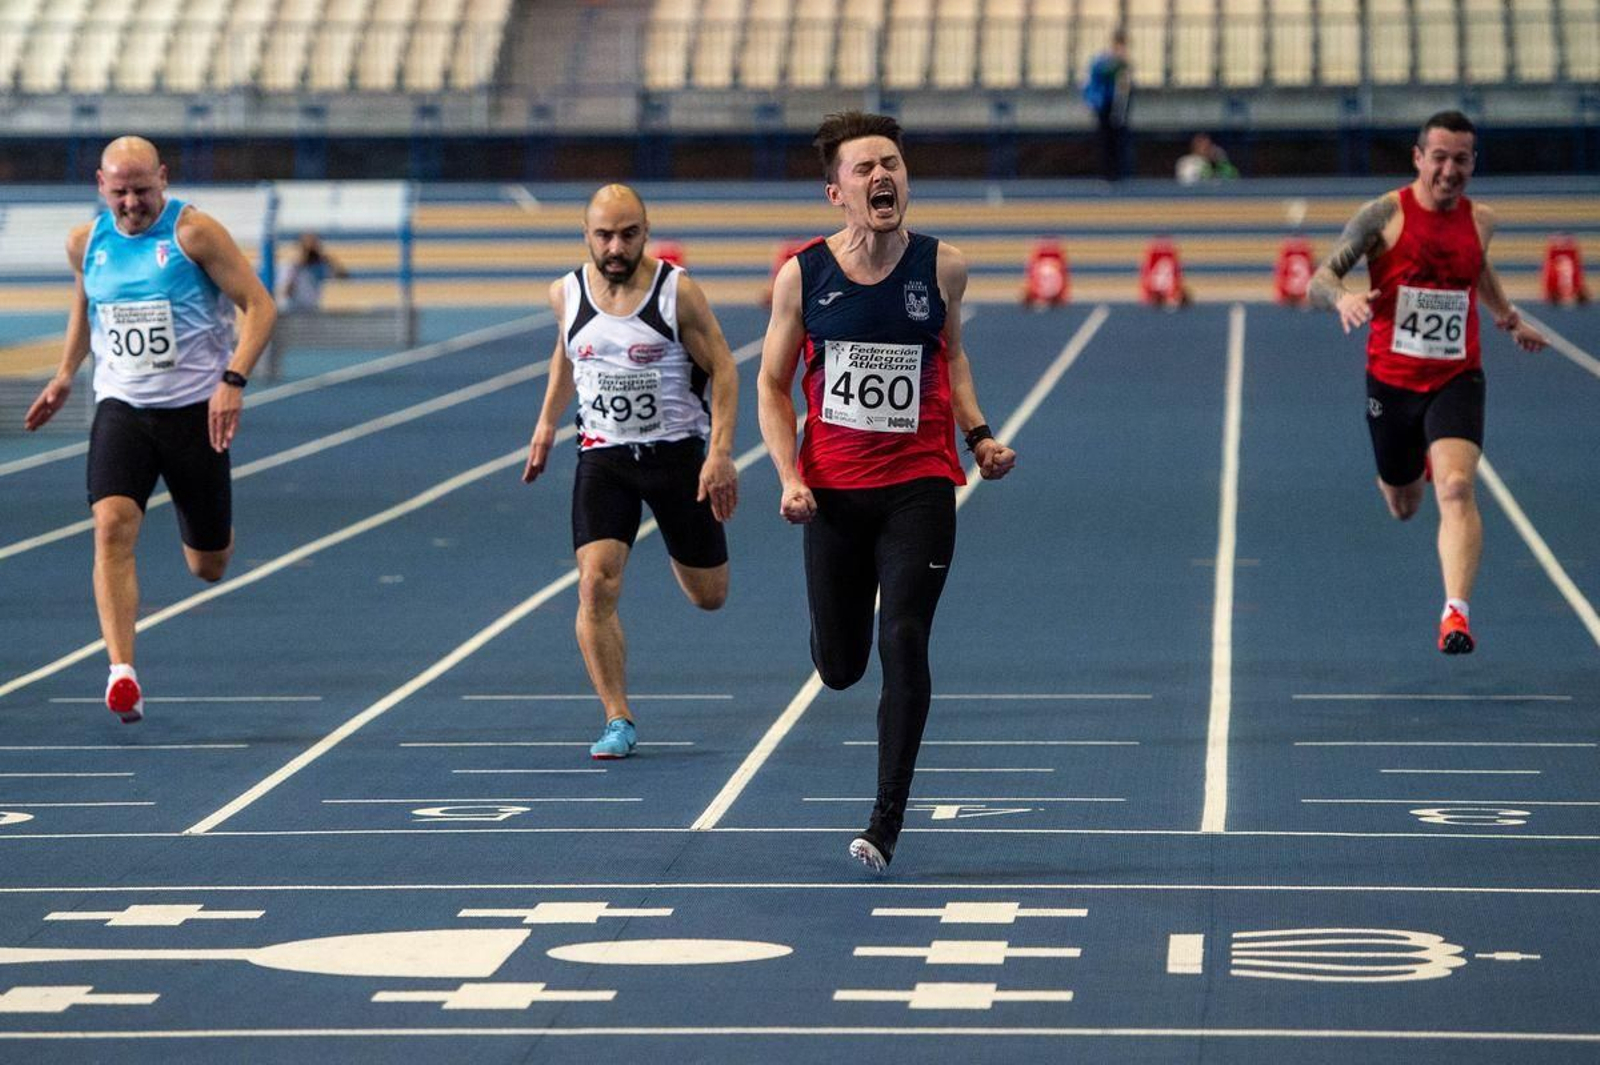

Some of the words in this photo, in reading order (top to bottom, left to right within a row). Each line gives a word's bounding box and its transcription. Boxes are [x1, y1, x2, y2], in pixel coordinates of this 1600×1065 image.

[1400, 311, 1462, 342] 426
[108, 326, 170, 357] 305
[849, 344, 918, 356] Federación
[848, 352, 904, 364] Galega
[848, 361, 917, 371] Atletismo
[831, 371, 914, 411] 460
[592, 394, 657, 423] 493
[1408, 807, 1532, 826] 3
